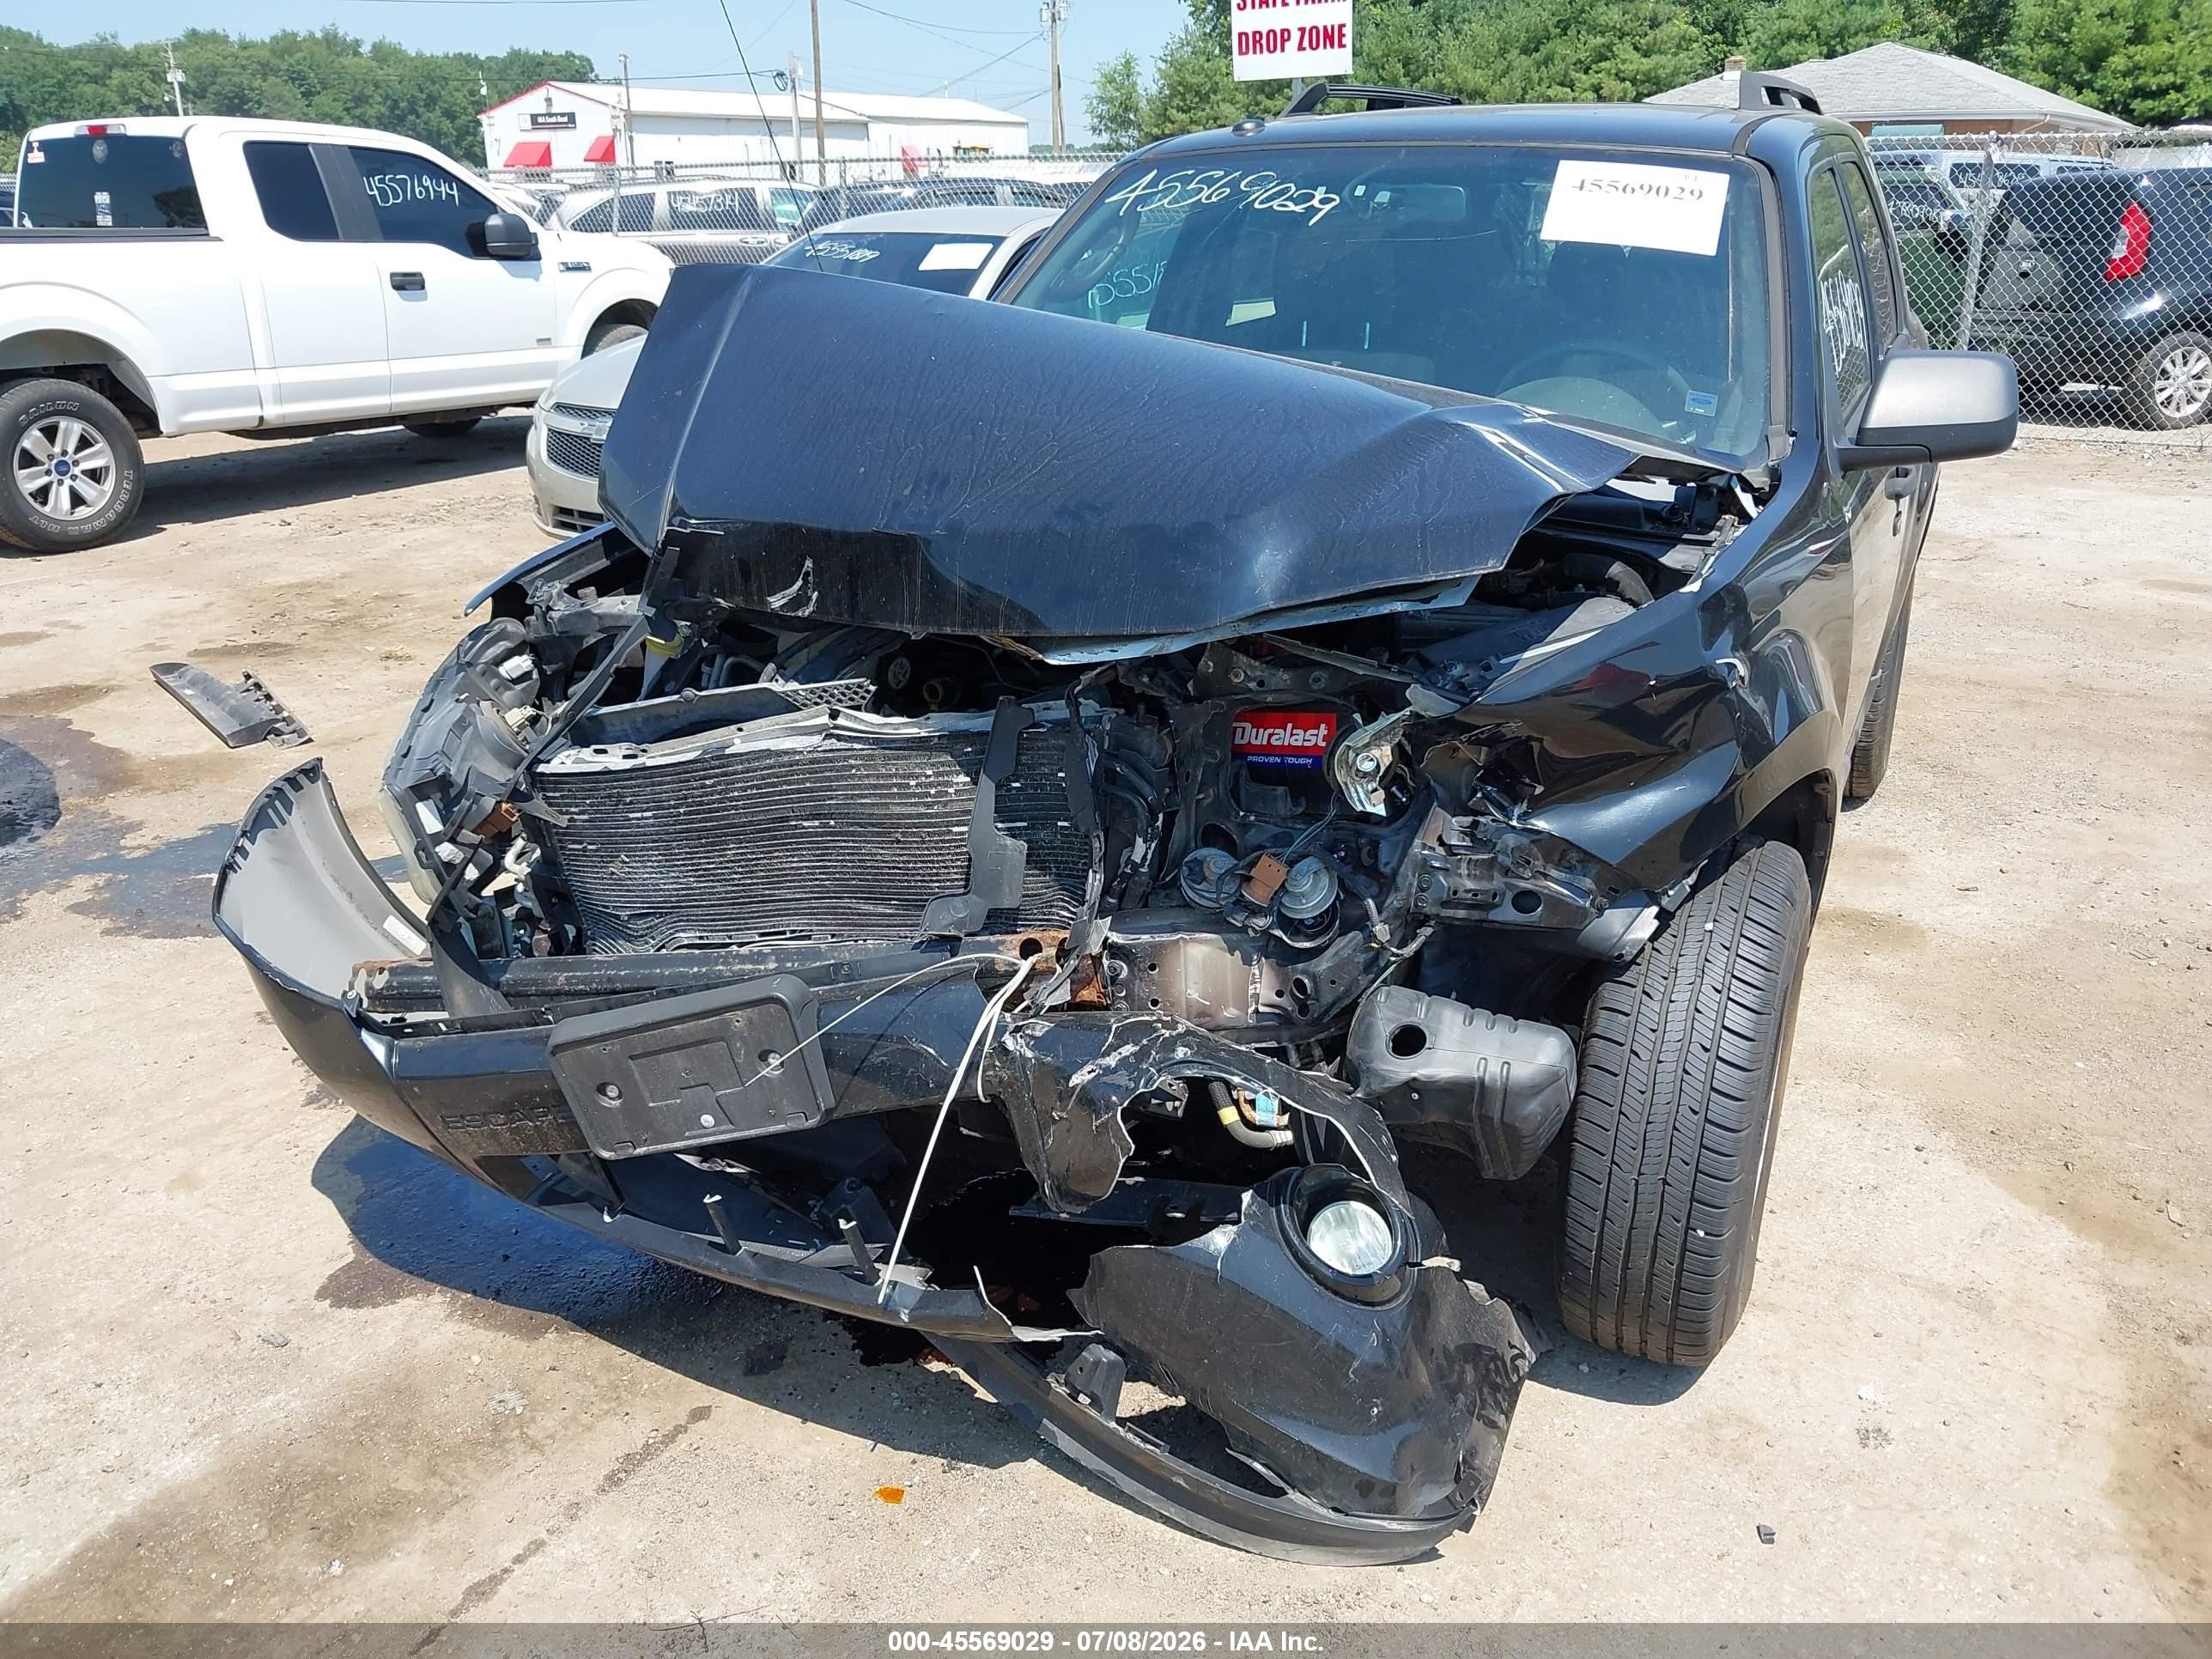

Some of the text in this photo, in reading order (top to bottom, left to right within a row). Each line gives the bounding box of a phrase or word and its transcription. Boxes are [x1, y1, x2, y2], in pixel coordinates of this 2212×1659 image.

[1237, 23, 1346, 56] DROP ZONE
[362, 173, 459, 207] 45576944
[1104, 168, 1340, 226] 45569029
[1571, 179, 1704, 201] 45569029
[1231, 722, 1328, 747] Duralast
